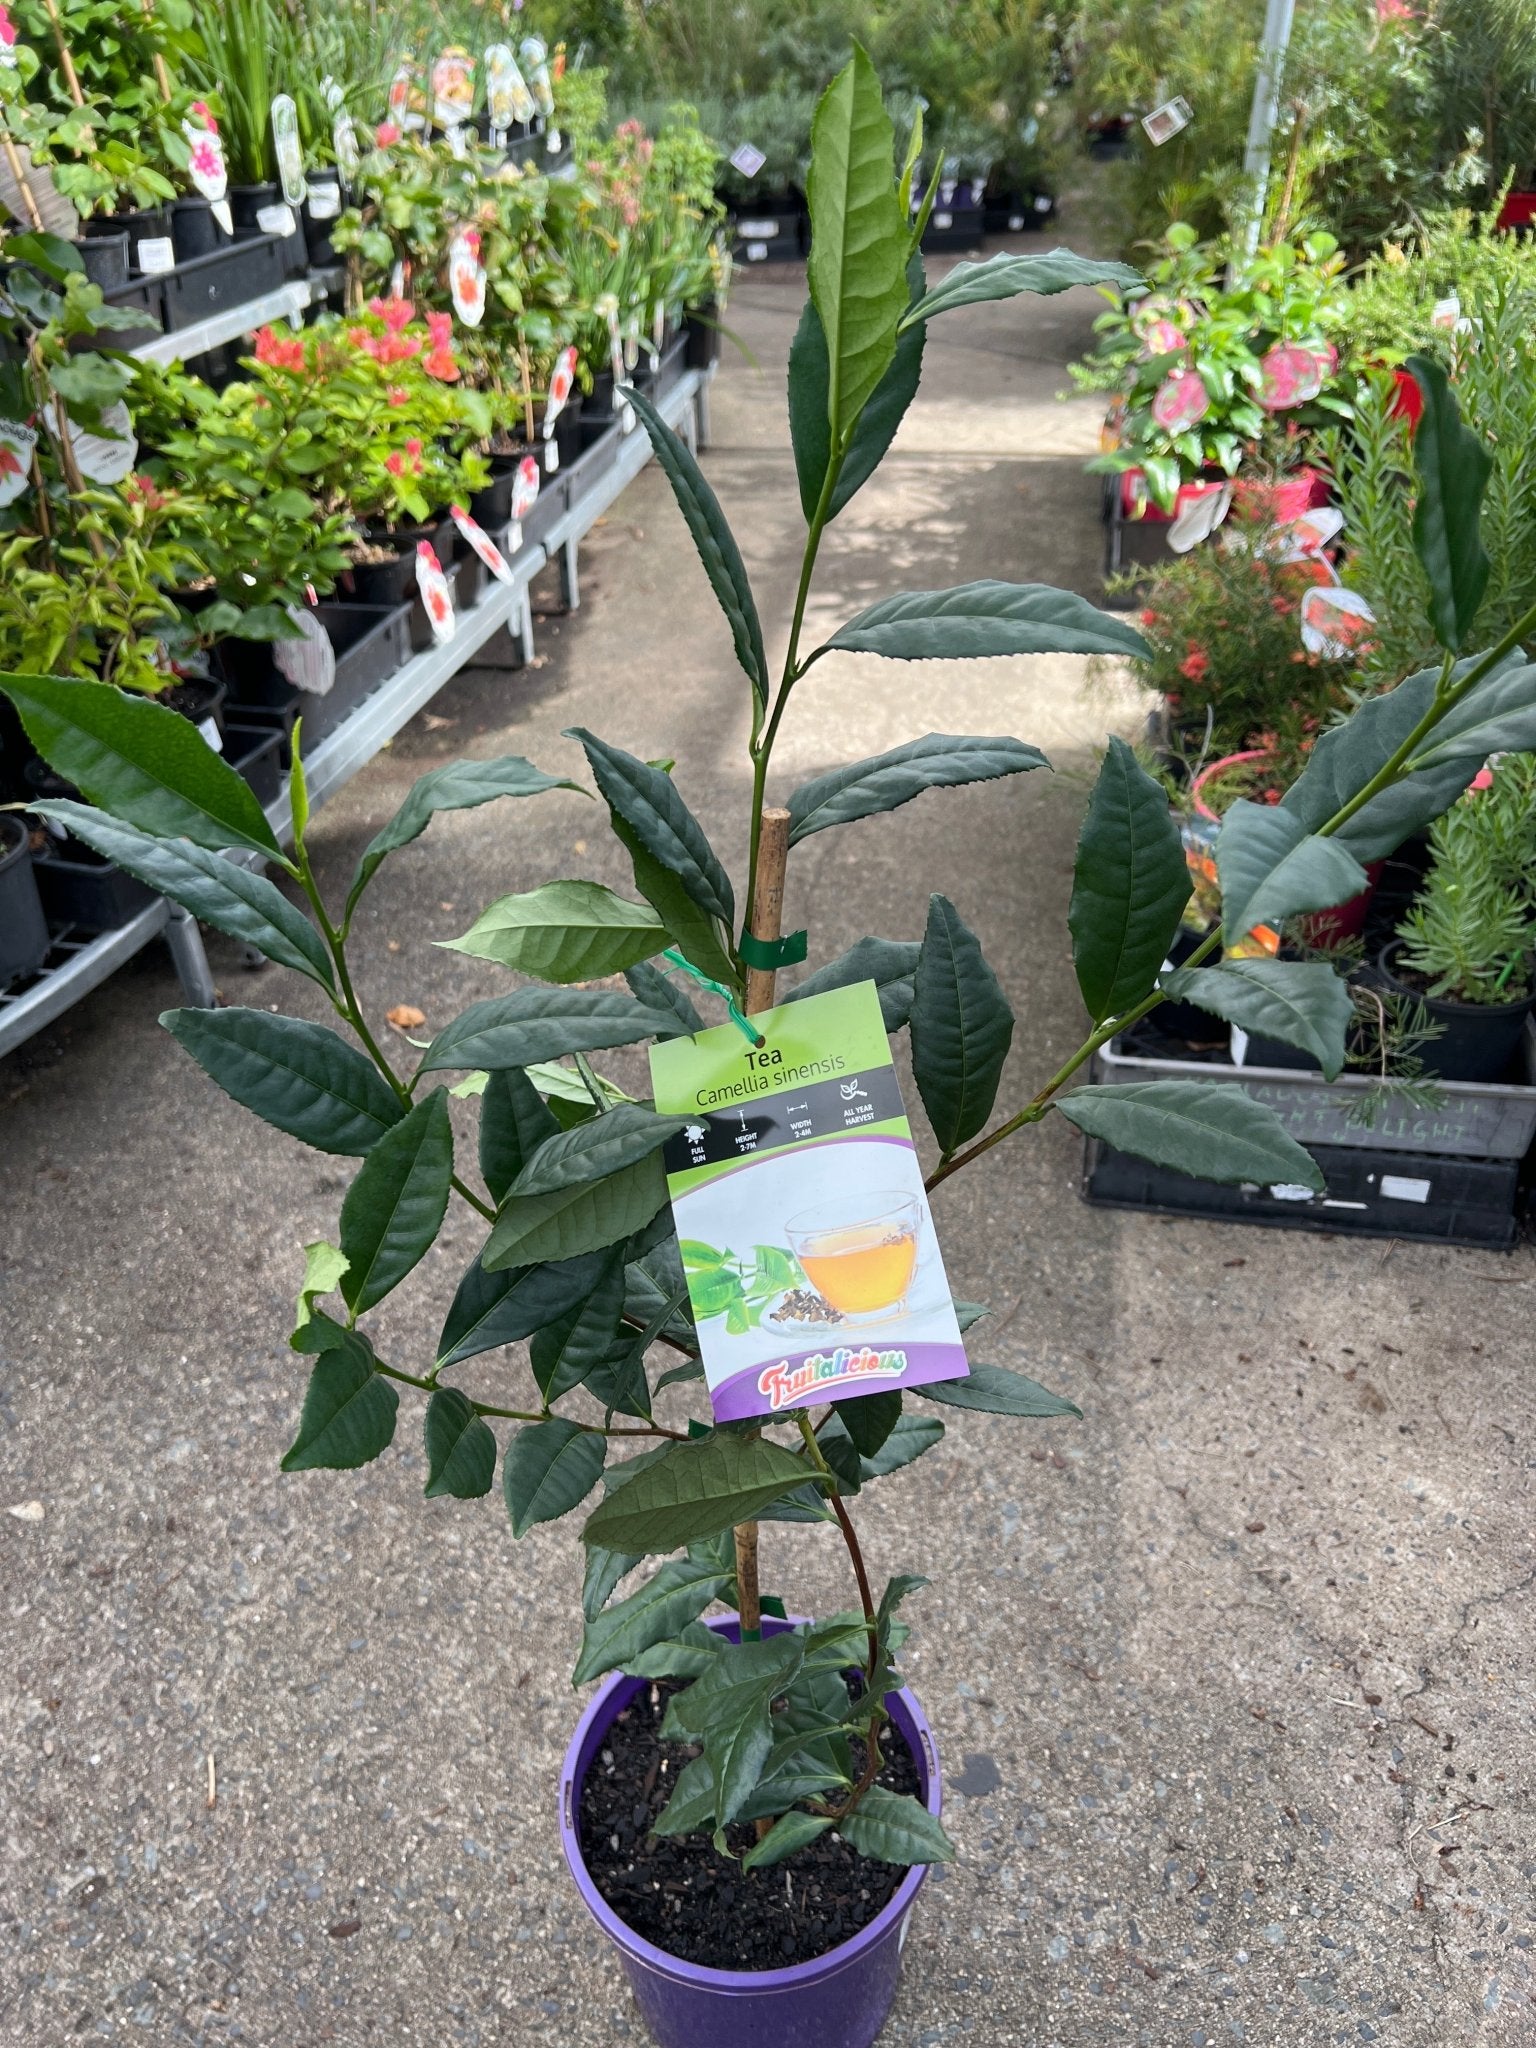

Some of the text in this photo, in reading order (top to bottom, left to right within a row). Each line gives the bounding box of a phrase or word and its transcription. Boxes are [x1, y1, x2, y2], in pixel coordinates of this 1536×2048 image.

[744, 1049, 783, 1071] Tea
[696, 1053, 846, 1107] Camellia sinensis
[843, 1103, 874, 1117] ALL YEAR
[789, 1118, 813, 1130] WIDTH
[845, 1112, 875, 1126] HARVEST
[734, 1132, 758, 1144] HEIGHT
[794, 1127, 812, 1139] 2-4M
[691, 1146, 705, 1155] FULL
[740, 1141, 757, 1152] 2-7M
[692, 1154, 706, 1164] SUN
[760, 1348, 906, 1409] Fruitalicious
